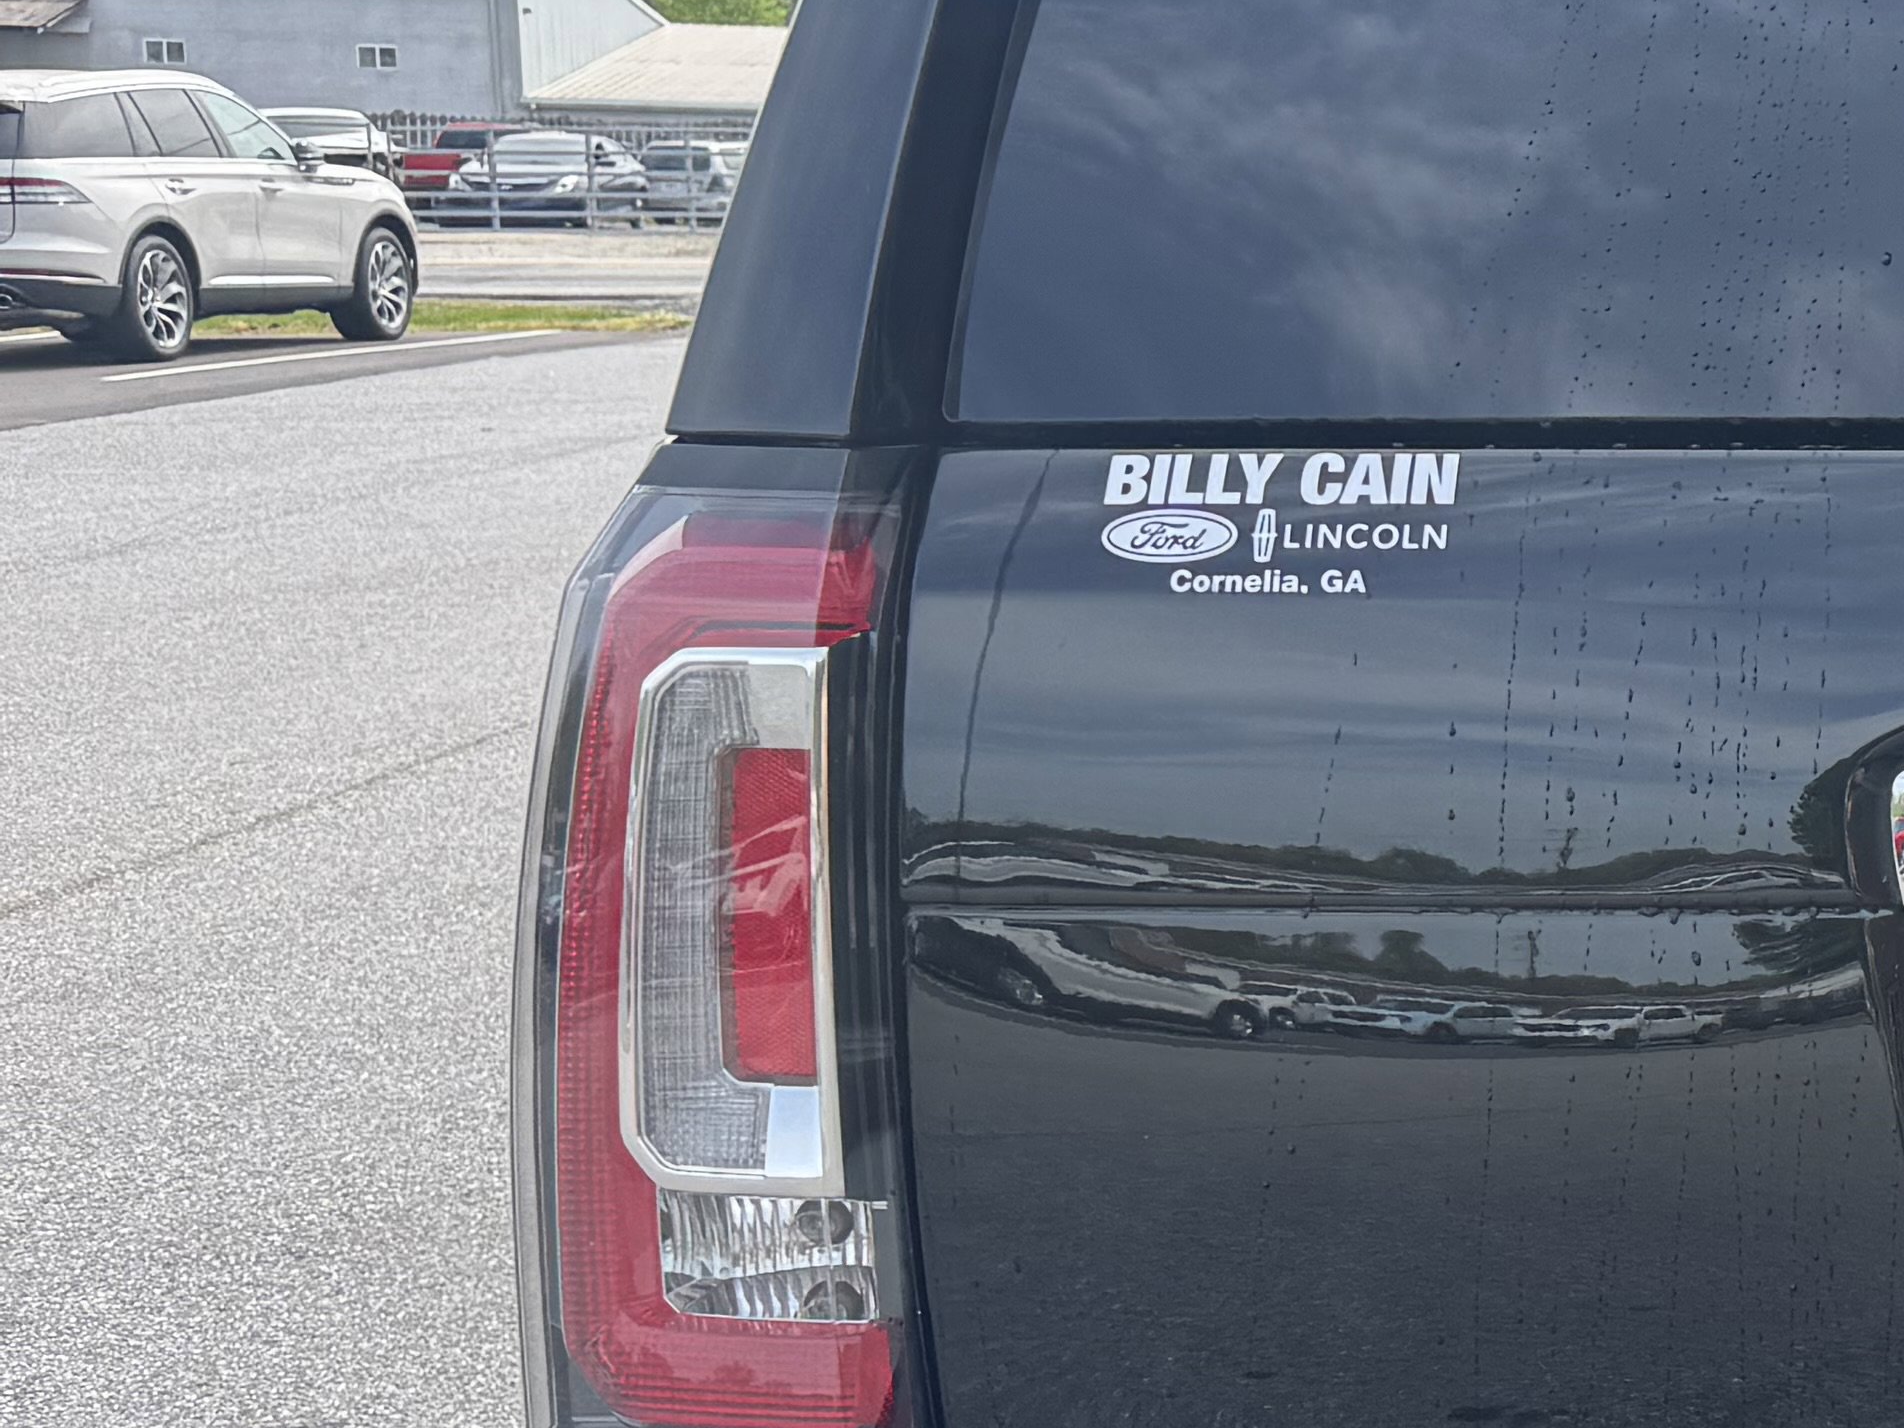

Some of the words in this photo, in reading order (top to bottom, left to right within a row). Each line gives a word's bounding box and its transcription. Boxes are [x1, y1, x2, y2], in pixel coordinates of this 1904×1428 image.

[1103, 453, 1284, 505] BILLY
[1300, 452, 1460, 505] CAIN
[1283, 524, 1448, 550] LINCOLN
[1170, 569, 1308, 594] Cornelia,
[1320, 570, 1366, 593] GA
